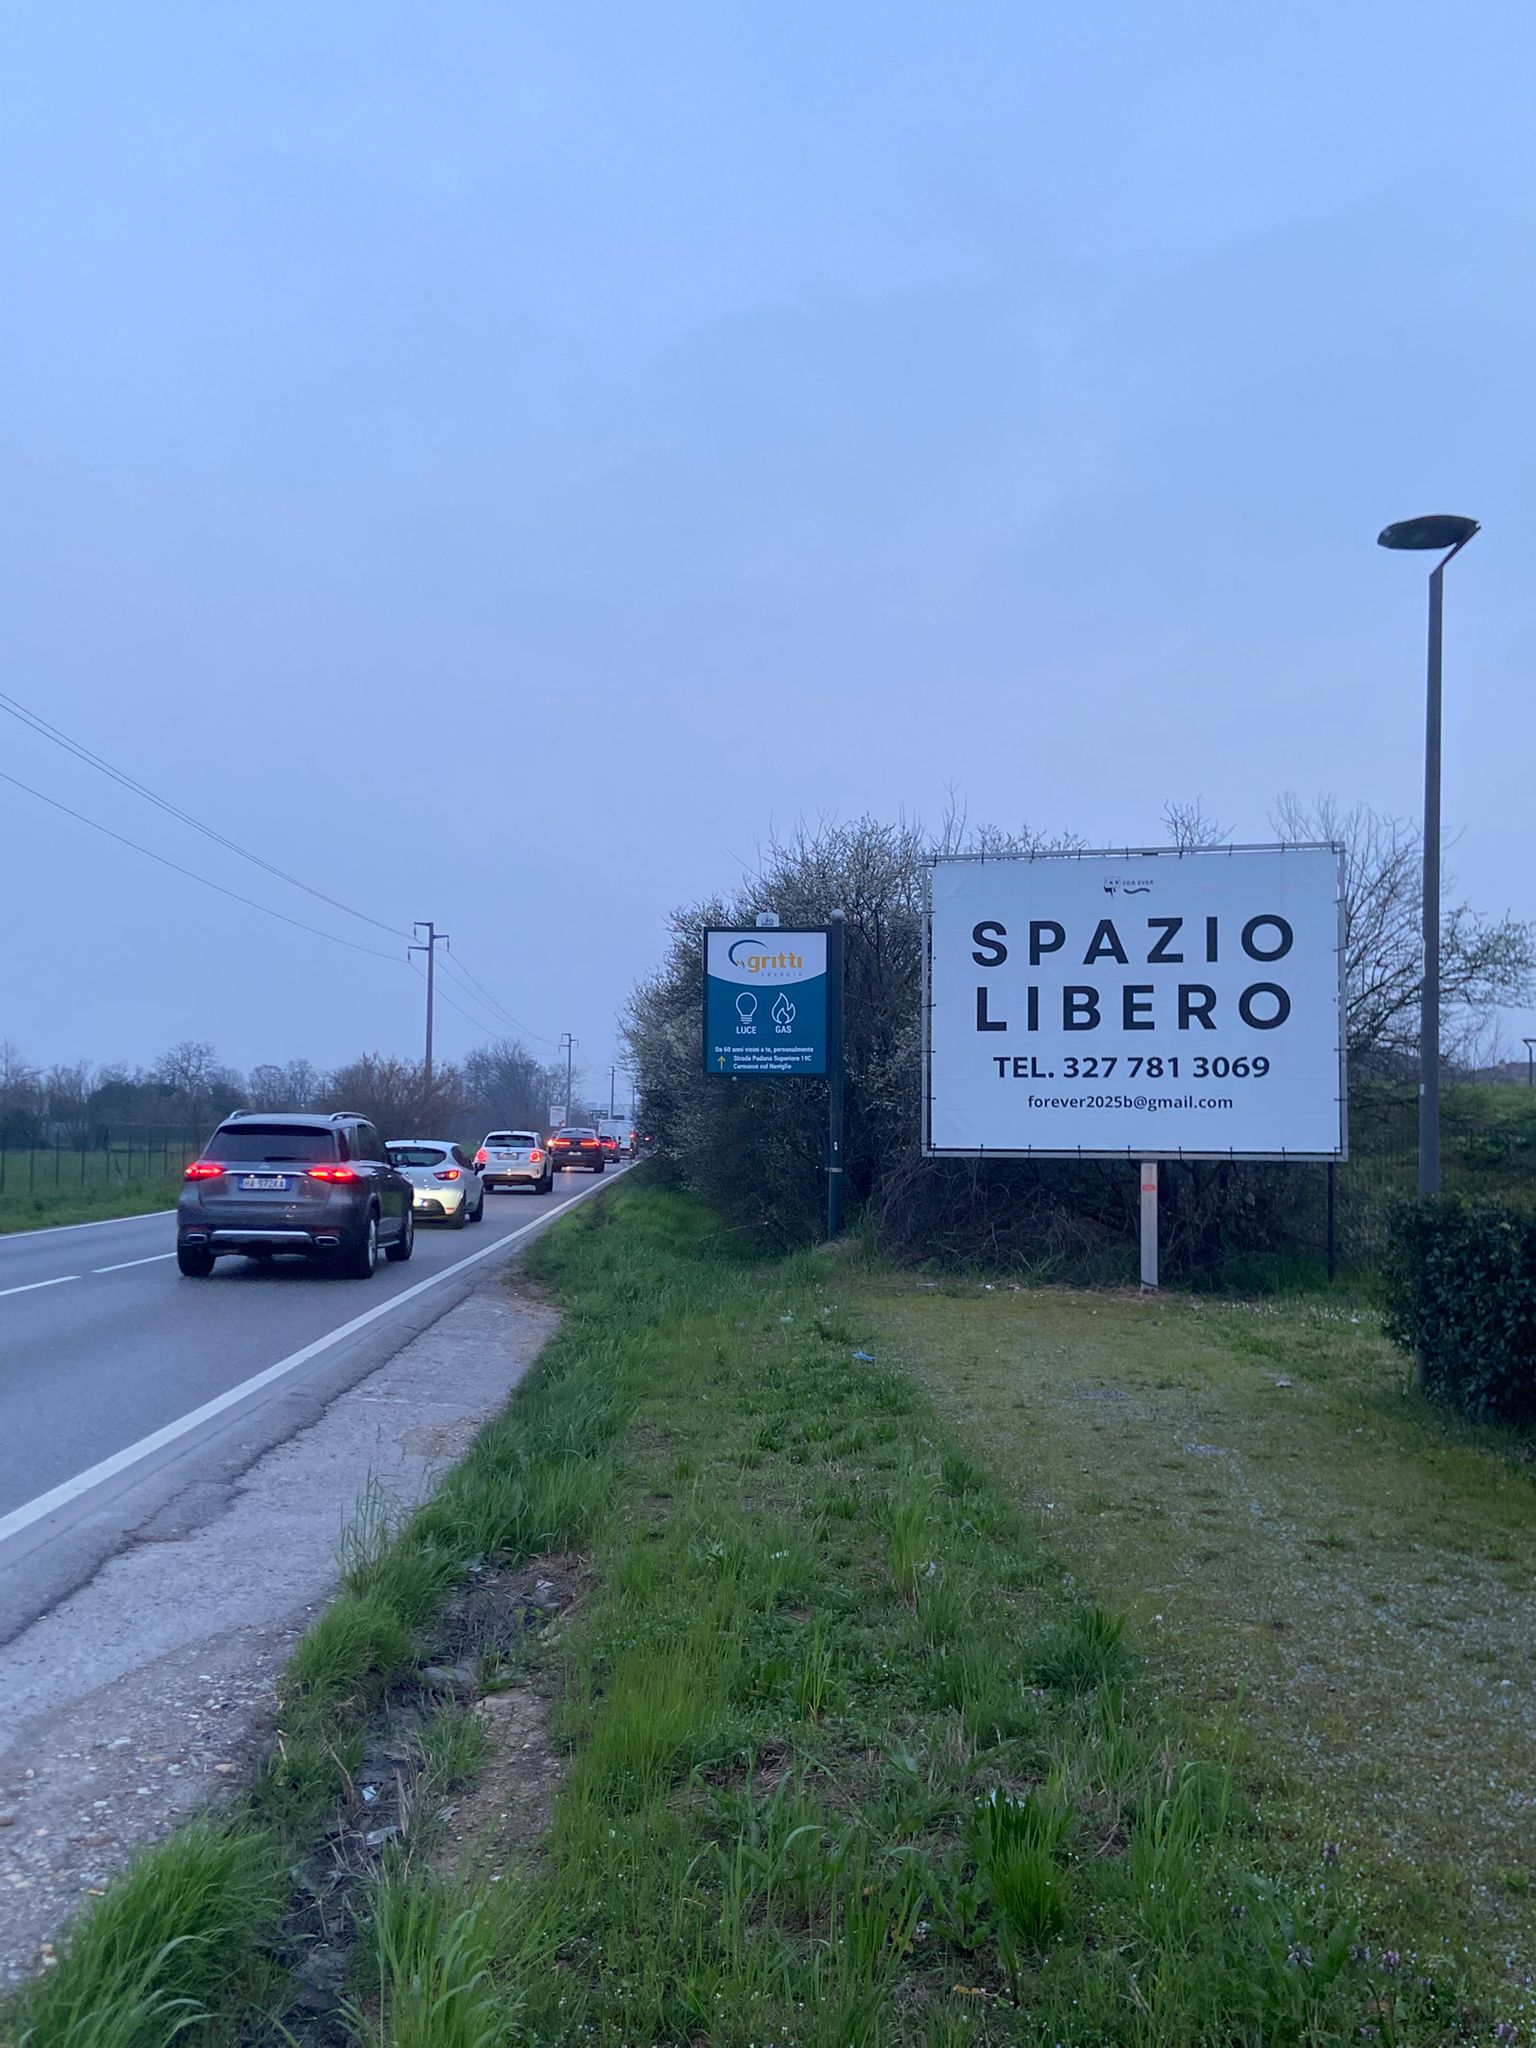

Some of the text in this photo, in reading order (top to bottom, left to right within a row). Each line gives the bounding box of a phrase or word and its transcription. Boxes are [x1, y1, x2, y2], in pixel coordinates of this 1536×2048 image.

[971, 913, 1295, 968] SPAZIO
[748, 952, 803, 973] gritti
[976, 981, 1291, 1032] LIBERO
[736, 1025, 757, 1034] LUCE
[775, 1025, 792, 1033] GAS
[993, 1056, 1270, 1079] TEL. 327 781 3069
[1027, 1094, 1234, 1112] forever2025b@gmail.com
